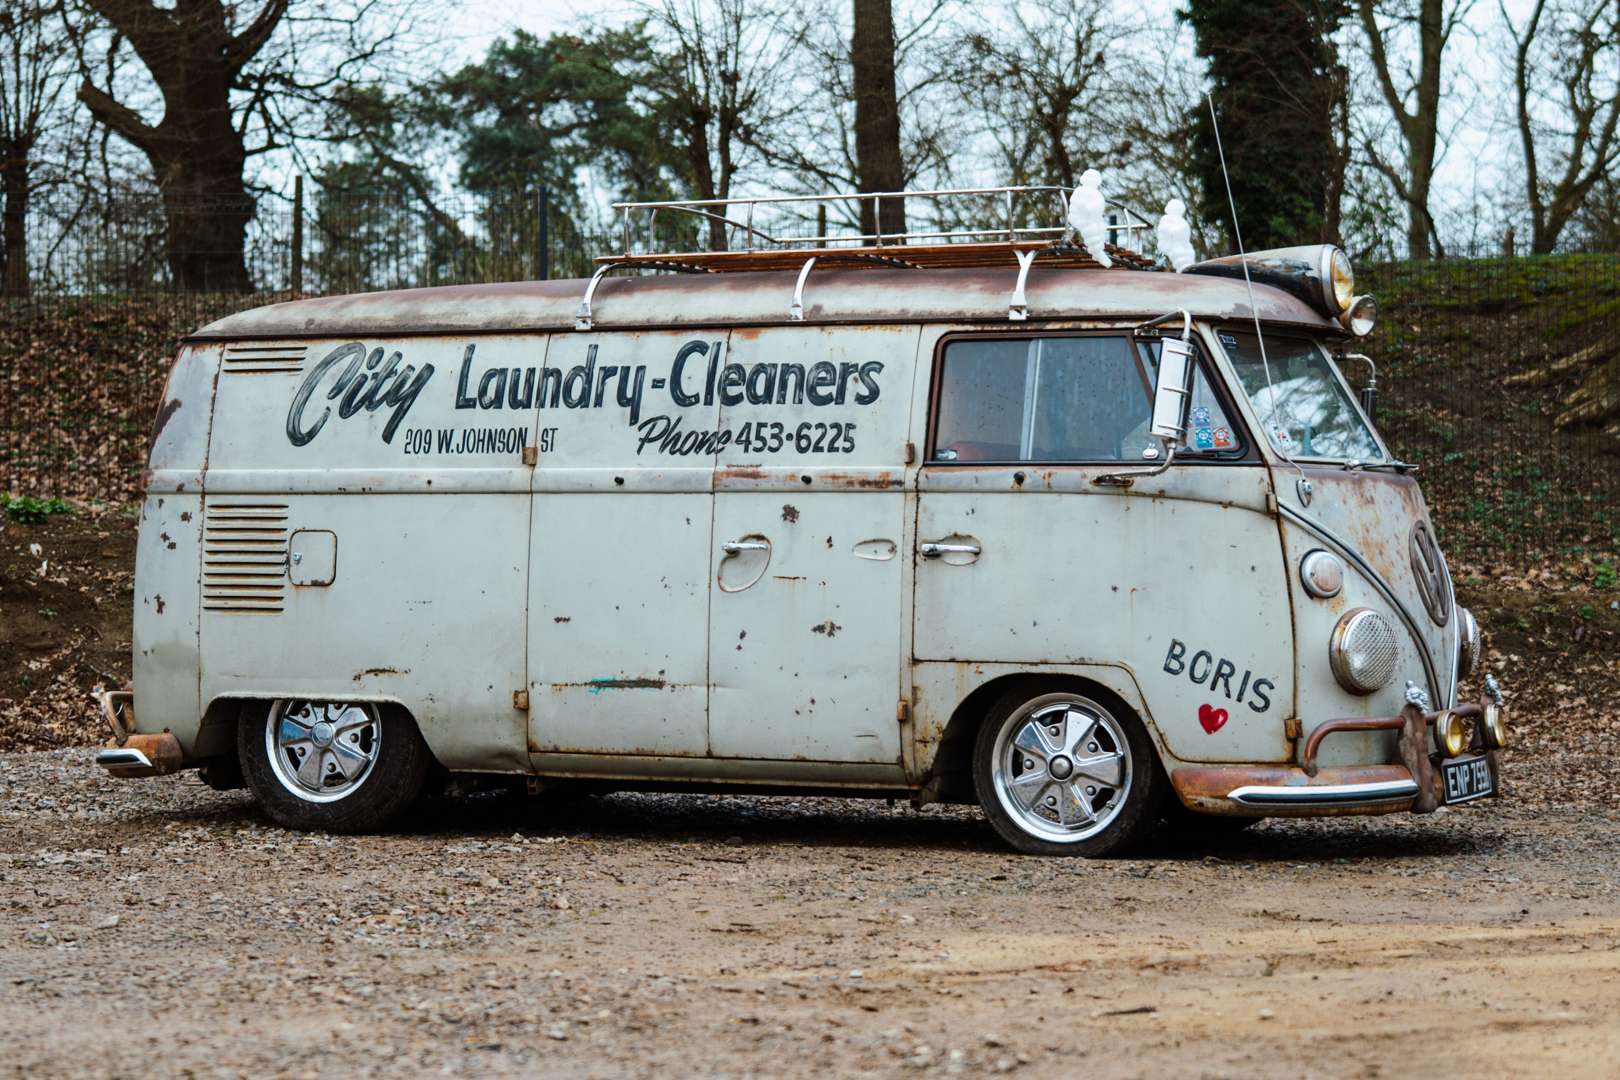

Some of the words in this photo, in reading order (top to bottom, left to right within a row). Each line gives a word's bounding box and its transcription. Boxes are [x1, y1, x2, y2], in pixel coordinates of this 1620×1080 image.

[286, 342, 435, 447] City
[404, 428, 433, 454] 209
[540, 427, 559, 453] ST
[636, 415, 732, 456] Phone
[1163, 638, 1275, 713] BORIS
[1447, 764, 1470, 797] ENP
